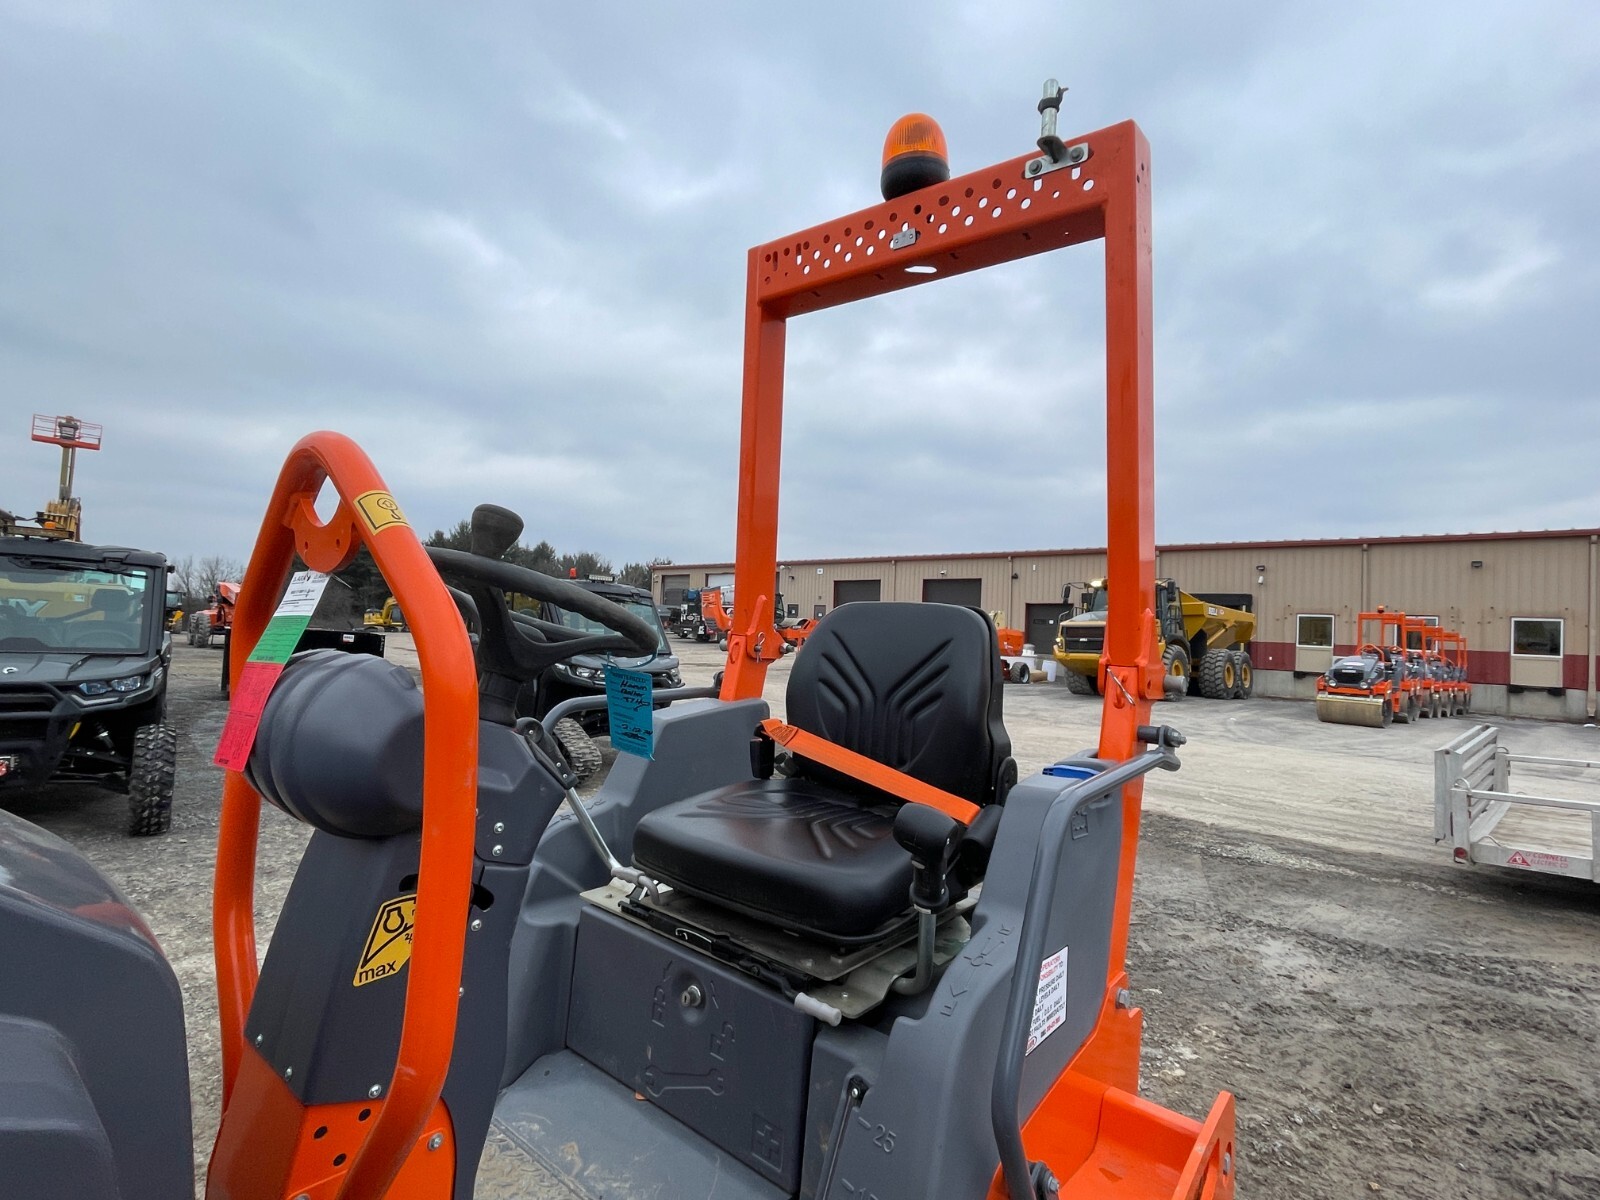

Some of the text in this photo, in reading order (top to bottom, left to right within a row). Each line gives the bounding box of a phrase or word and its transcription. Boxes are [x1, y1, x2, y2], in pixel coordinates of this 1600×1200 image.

[359, 960, 396, 983] max
[1051, 982, 1060, 995] DAILY
[1035, 1004, 1044, 1017] DAILY
[872, 1123, 897, 1153] 25
